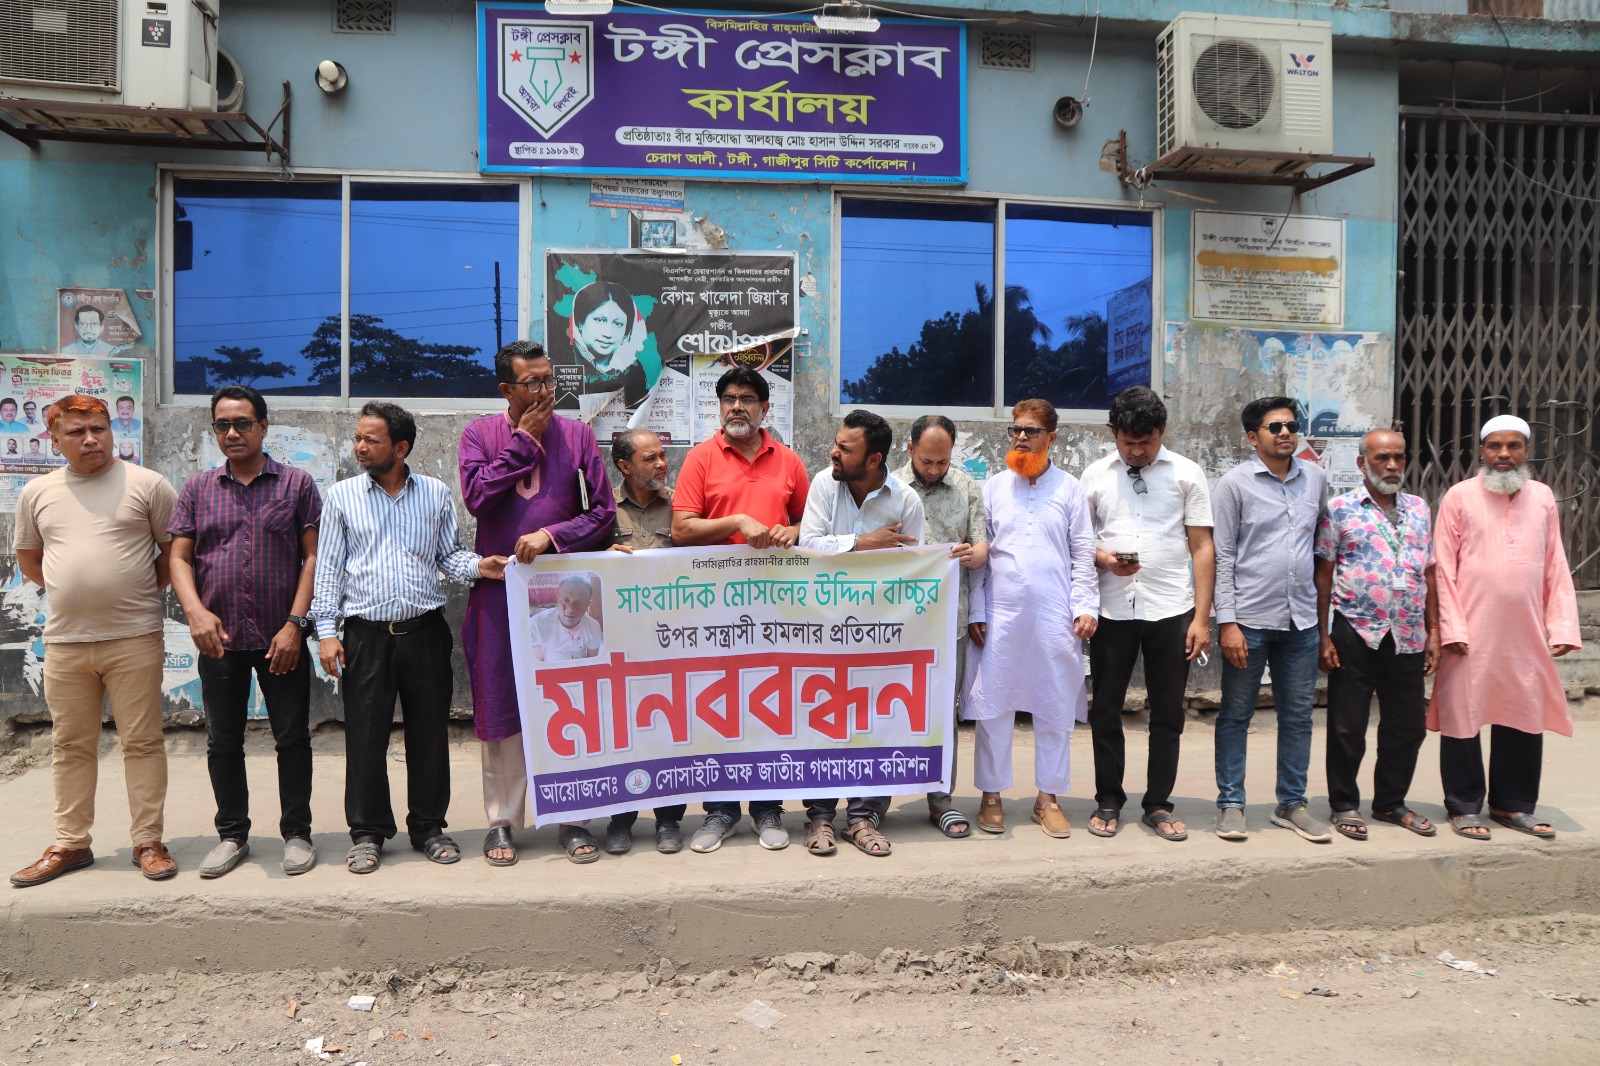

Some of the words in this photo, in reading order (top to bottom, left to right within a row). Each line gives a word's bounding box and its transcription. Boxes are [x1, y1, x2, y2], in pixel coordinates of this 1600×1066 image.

[511, 28, 532, 43] টঙ্গী
[537, 32, 582, 44] প্রেসক্লাব
[603, 22, 718, 69] টঙ্গী
[735, 38, 951, 79] প্রেসক্লাব
[1287, 69, 1319, 77] WALTON
[518, 85, 540, 112] আমরা
[681, 81, 877, 125] কার্যালয়
[514, 144, 538, 156] স্থাপিত
[622, 126, 671, 142] প্রতিষ্ঠাতাঃ
[674, 128, 691, 143] বীর
[695, 129, 741, 146] মুক্তিযোদ্ধা
[745, 133, 784, 148] আলহাজ্ব
[786, 135, 805, 147] মোঃ
[808, 136, 836, 148] হাসান
[839, 133, 866, 149] উদ্দিন
[868, 138, 901, 150] সরকার
[645, 152, 682, 165] চেরাগ
[762, 152, 809, 170] গাজীপুর
[813, 154, 840, 168] সিটি
[660, 289, 695, 305] বেগম
[699, 290, 743, 305] খালেদা
[709, 319, 733, 331] গভীর
[692, 557, 742, 569] বিসমিল্লাহির
[745, 555, 783, 567] রাহমানীর
[785, 555, 809, 566] রাহীম
[616, 575, 717, 613] সাংবাদিক
[723, 577, 809, 607] মোসলেহ
[814, 571, 877, 606] উদ্দিন
[882, 577, 942, 615] বাচ্চুর
[655, 621, 698, 648] উপর
[703, 614, 756, 648] সন্ত্রাসী
[761, 619, 824, 645] হামলার
[829, 615, 904, 646] প্রতিবাদে
[535, 649, 936, 757] মানববন্ধন
[539, 776, 618, 803] আয়োজনেঃ
[655, 757, 721, 790] সোসাইটি
[723, 763, 753, 784] অফ
[757, 753, 805, 783] জাতীয়
[810, 756, 874, 781] গণমাধ্যম
[878, 750, 930, 778] কমিশন
